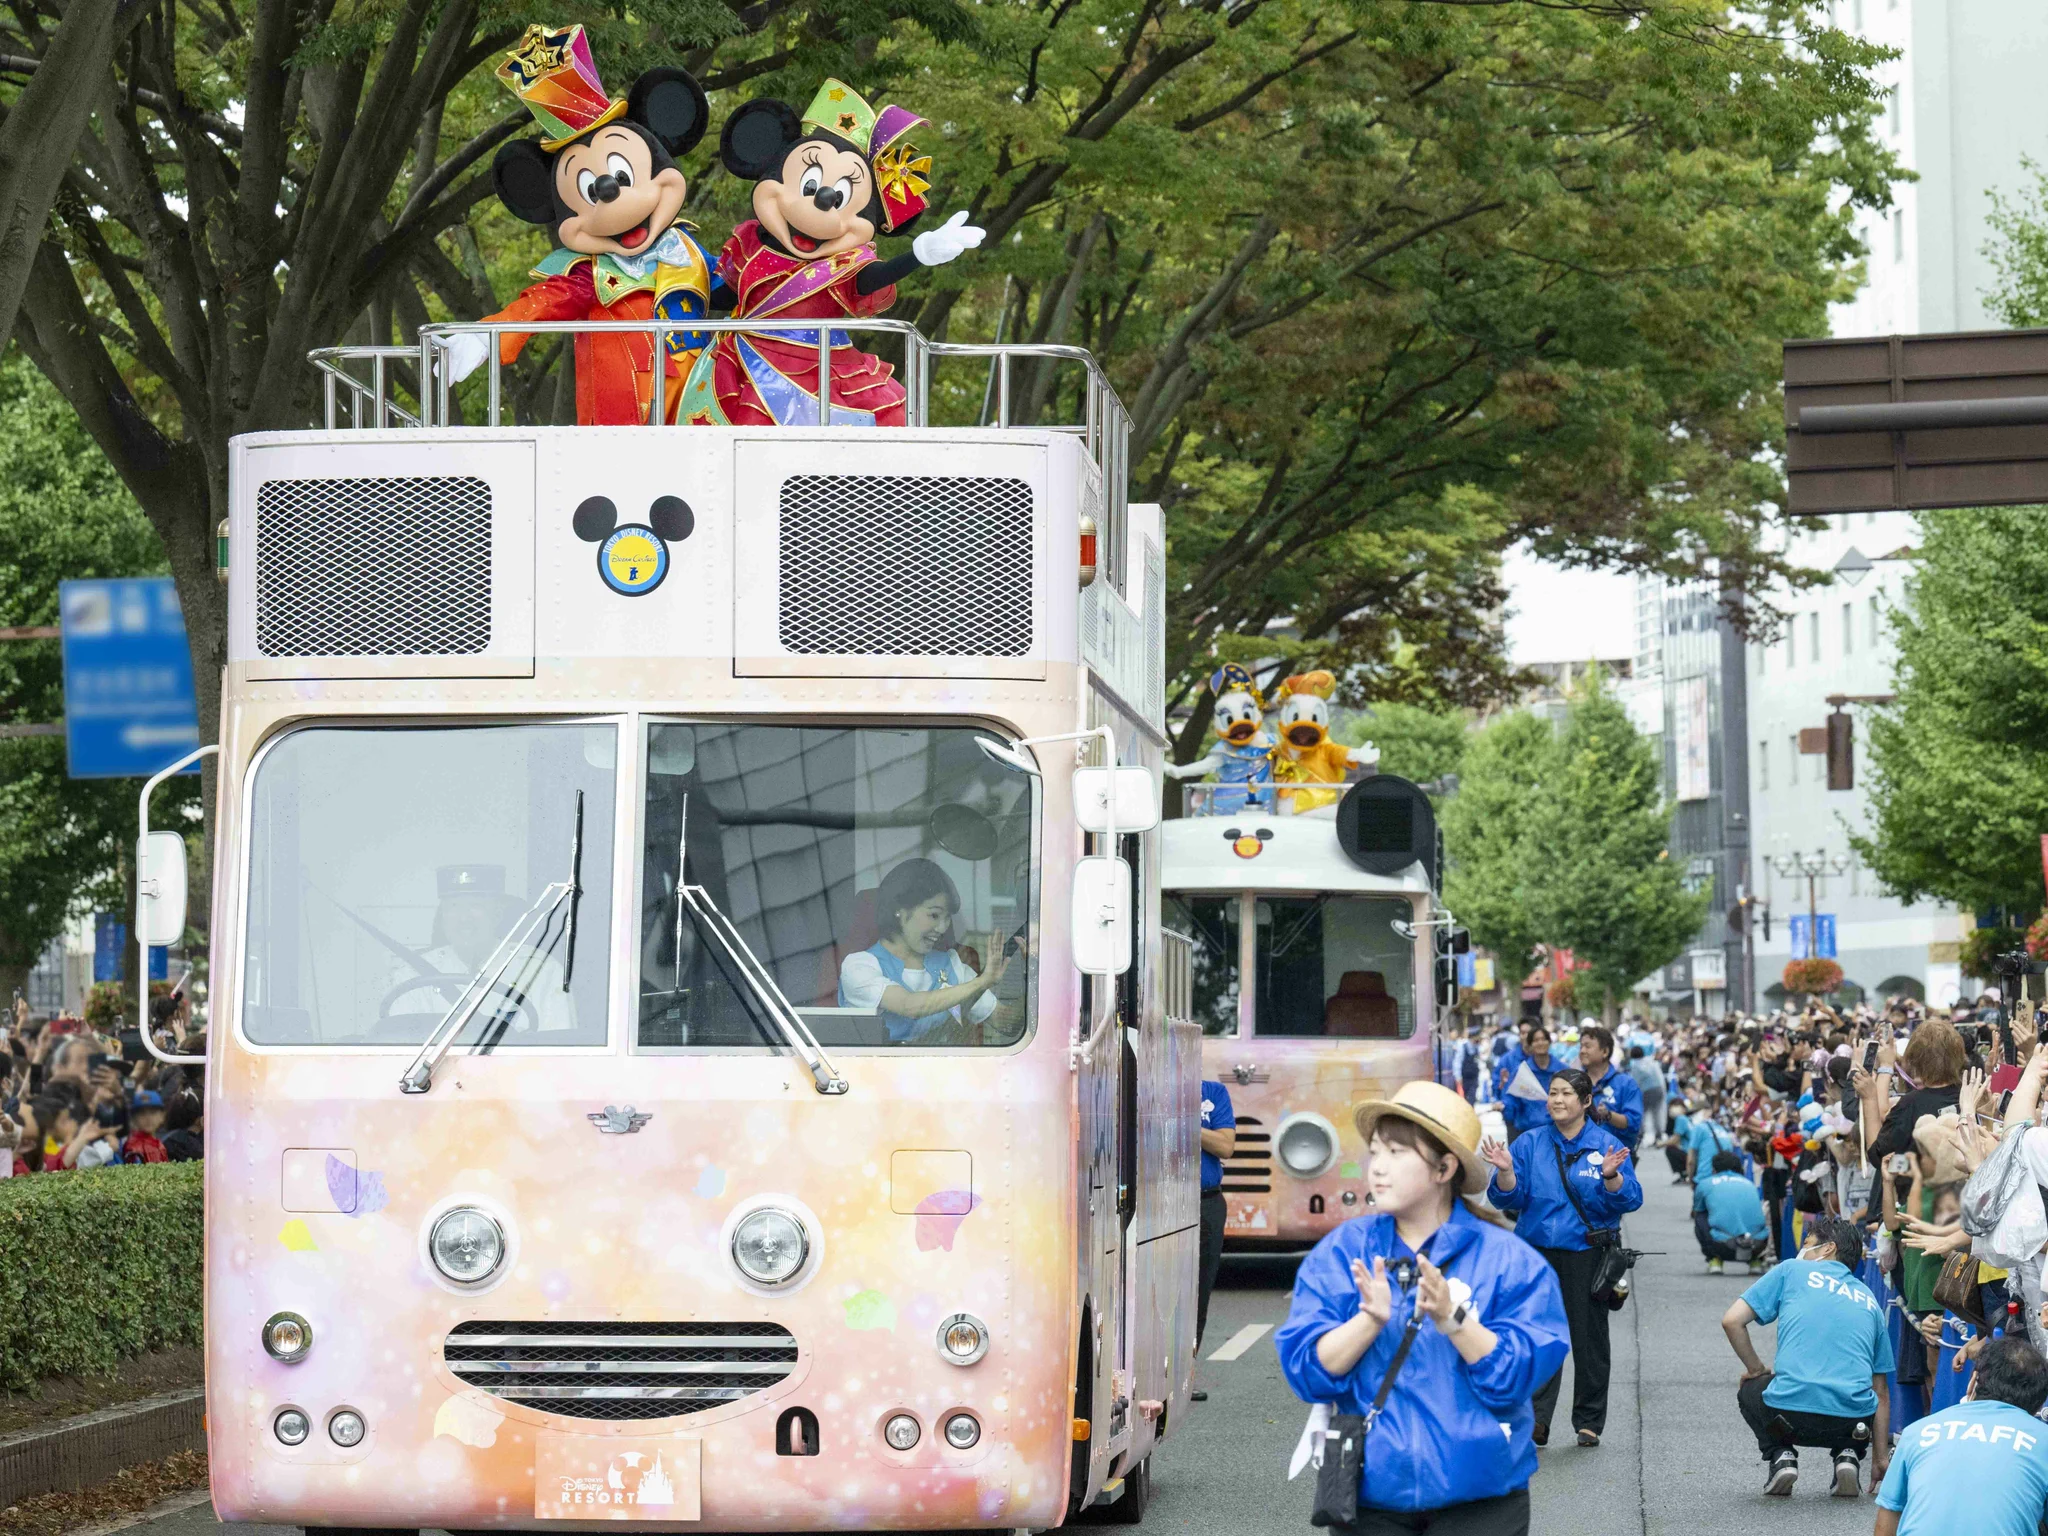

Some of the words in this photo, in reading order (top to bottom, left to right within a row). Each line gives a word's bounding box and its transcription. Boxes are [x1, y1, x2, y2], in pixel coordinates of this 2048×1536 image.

[603, 534, 619, 553] TOKYO
[620, 528, 644, 538] DISNEY
[644, 531, 664, 553] RESORT
[1807, 1271, 1877, 1311] STAFF
[1919, 1421, 2037, 1452] STAFF
[559, 1475, 604, 1497] Disney
[561, 1491, 635, 1504] RESORT
